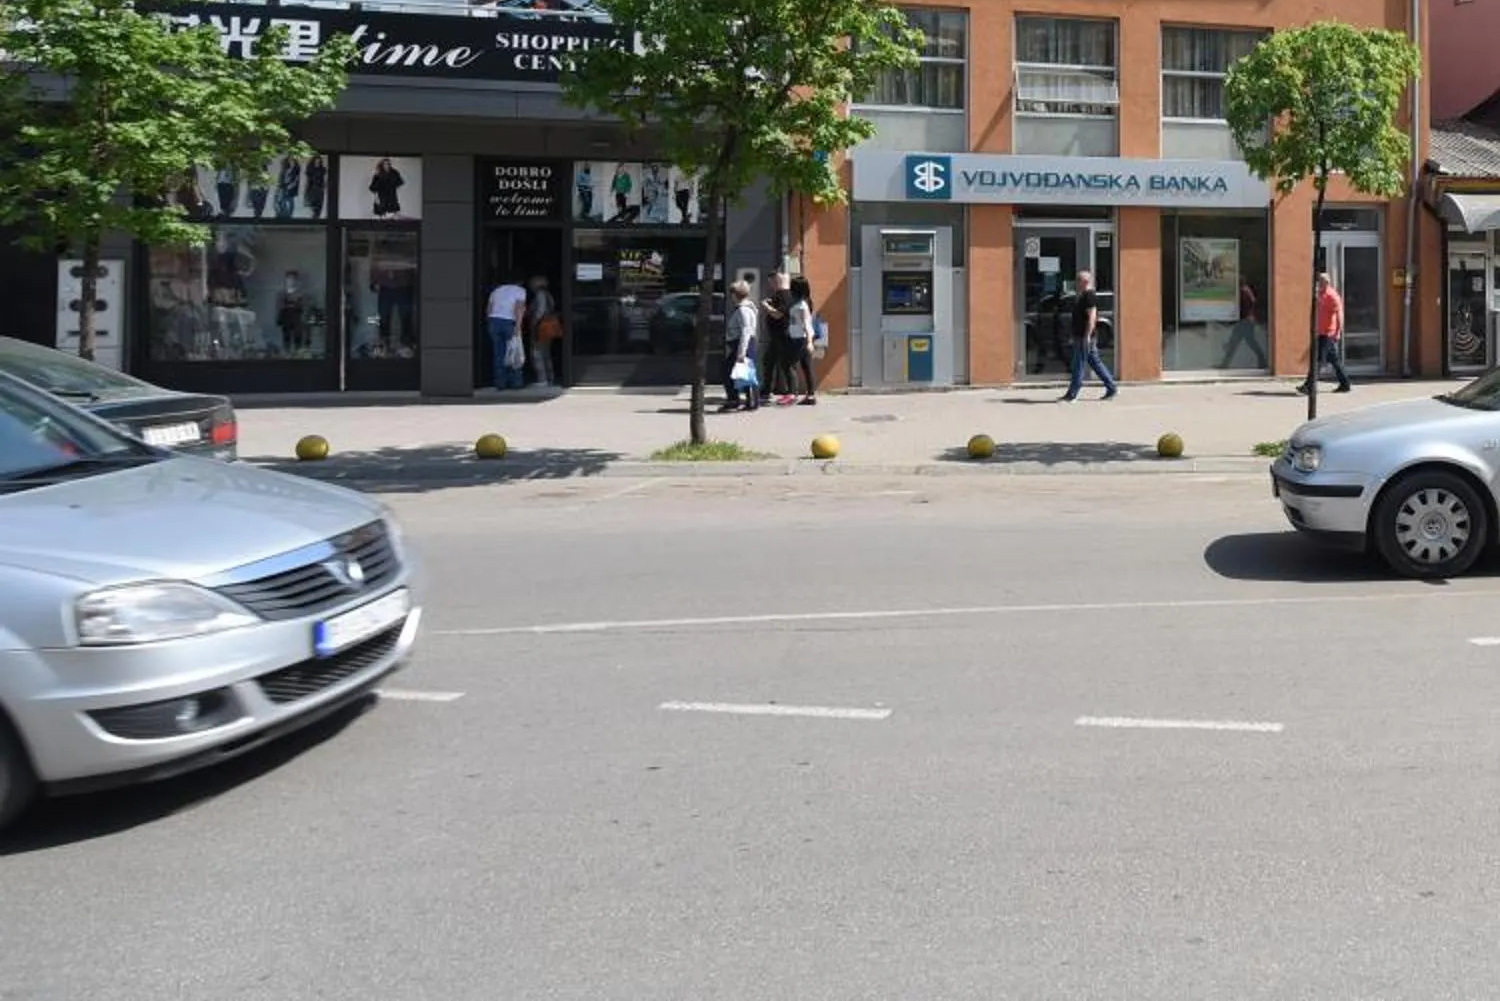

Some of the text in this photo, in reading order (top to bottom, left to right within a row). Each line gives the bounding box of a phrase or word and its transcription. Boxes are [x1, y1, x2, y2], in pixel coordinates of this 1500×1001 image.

[345, 23, 482, 68] time
[495, 32, 626, 56] SHOPPIG
[495, 166, 552, 177] DOBRO
[1150, 174, 1228, 193] BANKA
